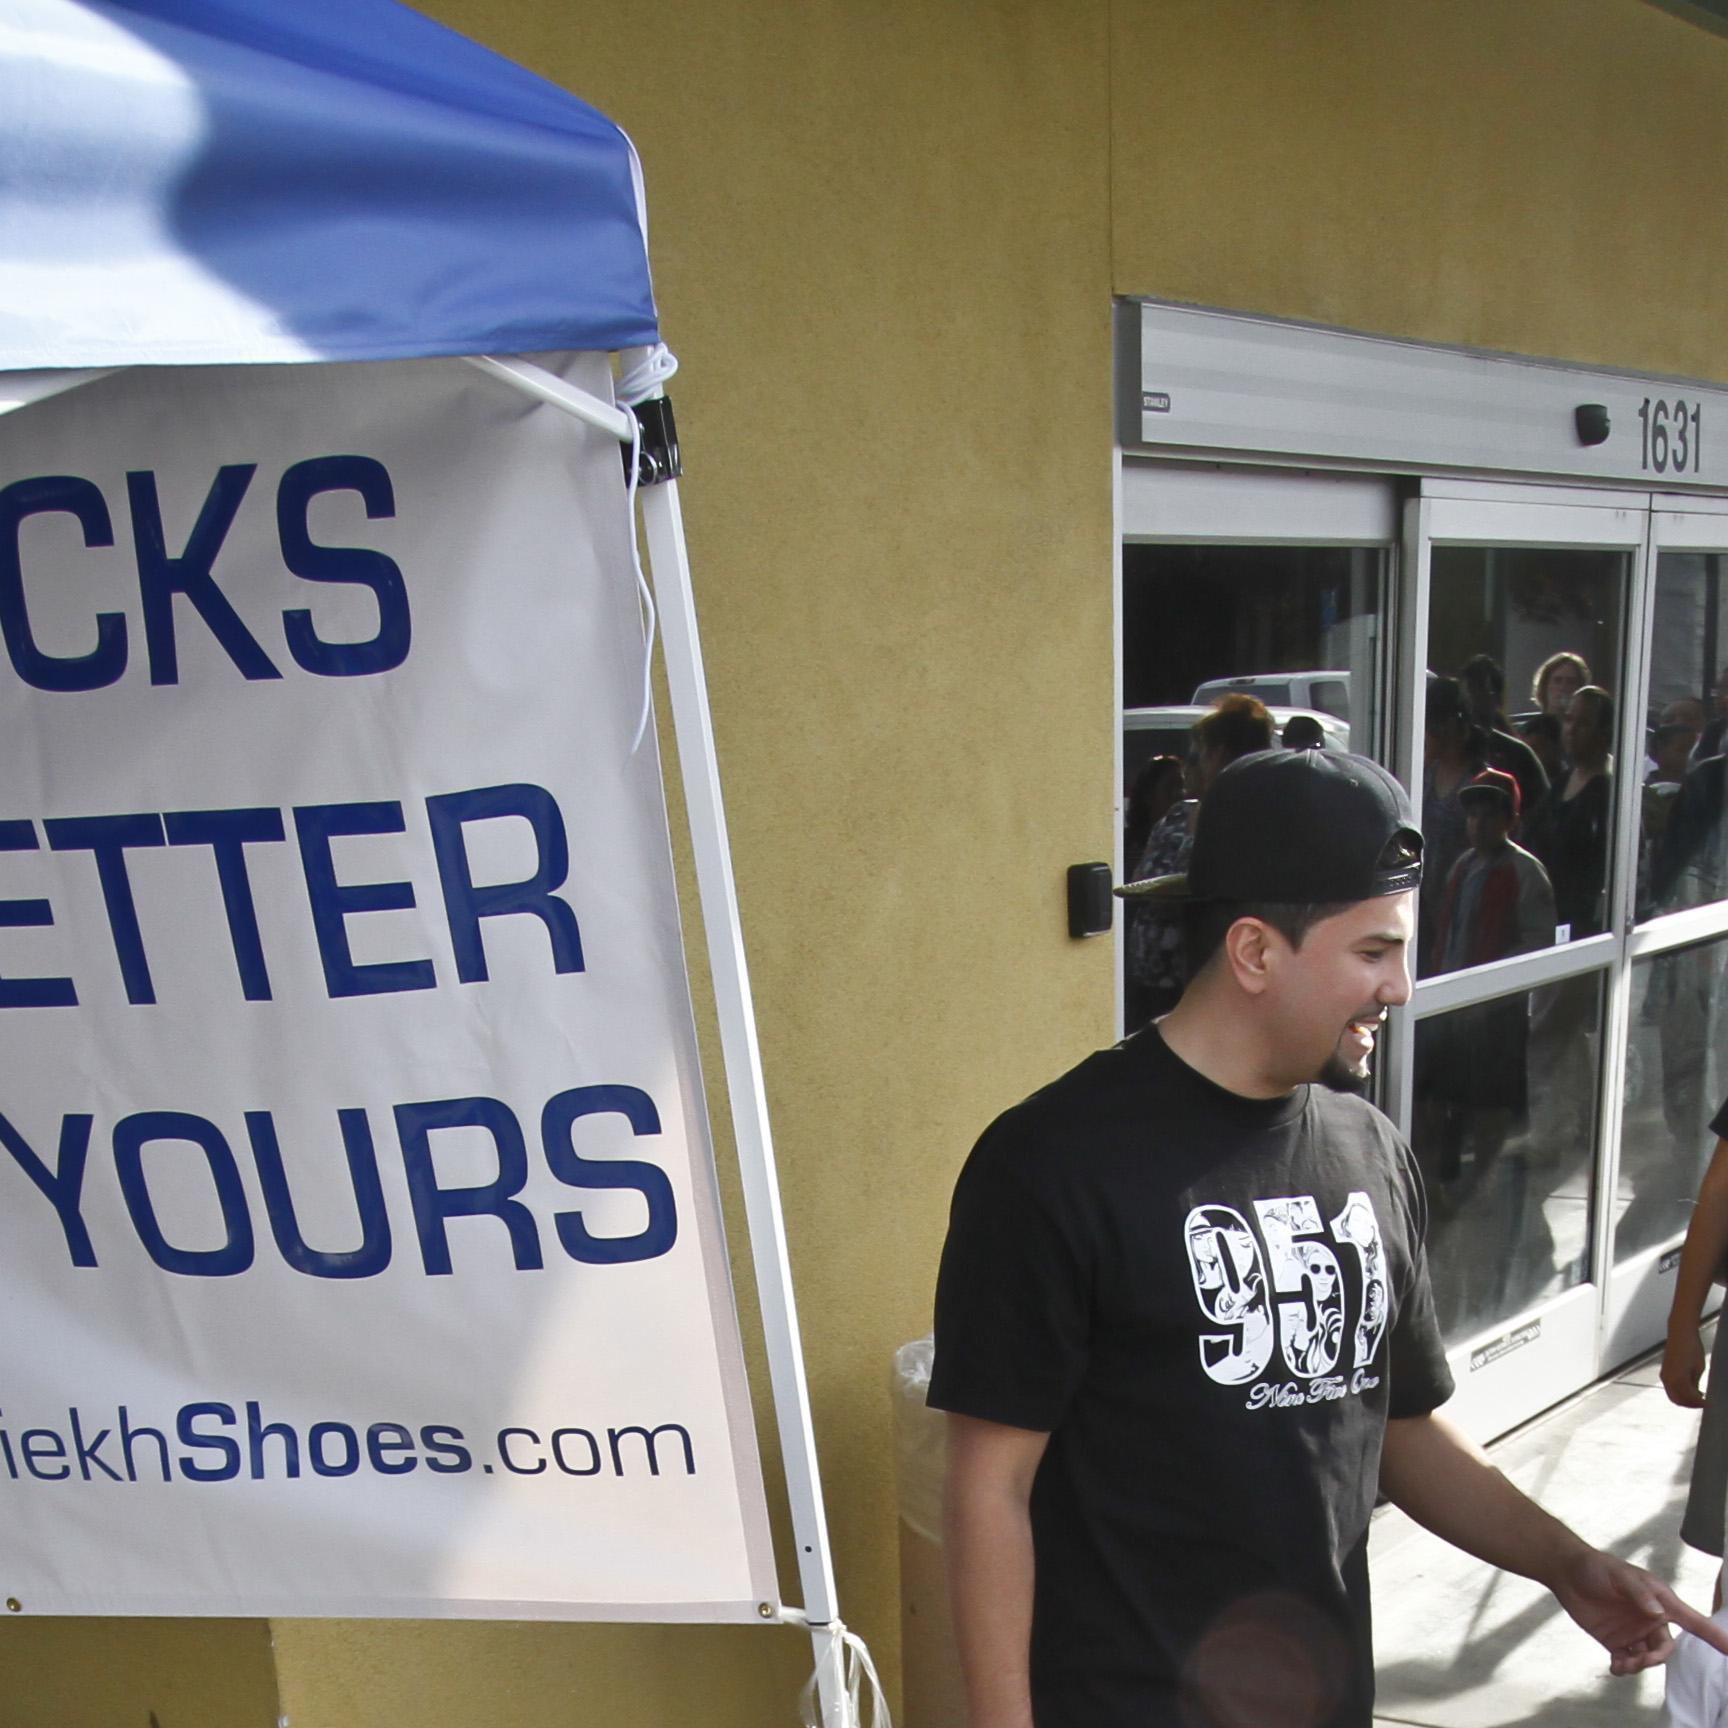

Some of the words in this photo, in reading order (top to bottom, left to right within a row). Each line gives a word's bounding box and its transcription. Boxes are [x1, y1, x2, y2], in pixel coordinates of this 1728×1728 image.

[1638, 397, 1701, 474] 1631
[1183, 1192, 1390, 1386] 951
[1245, 1382, 1305, 1410] Nine
